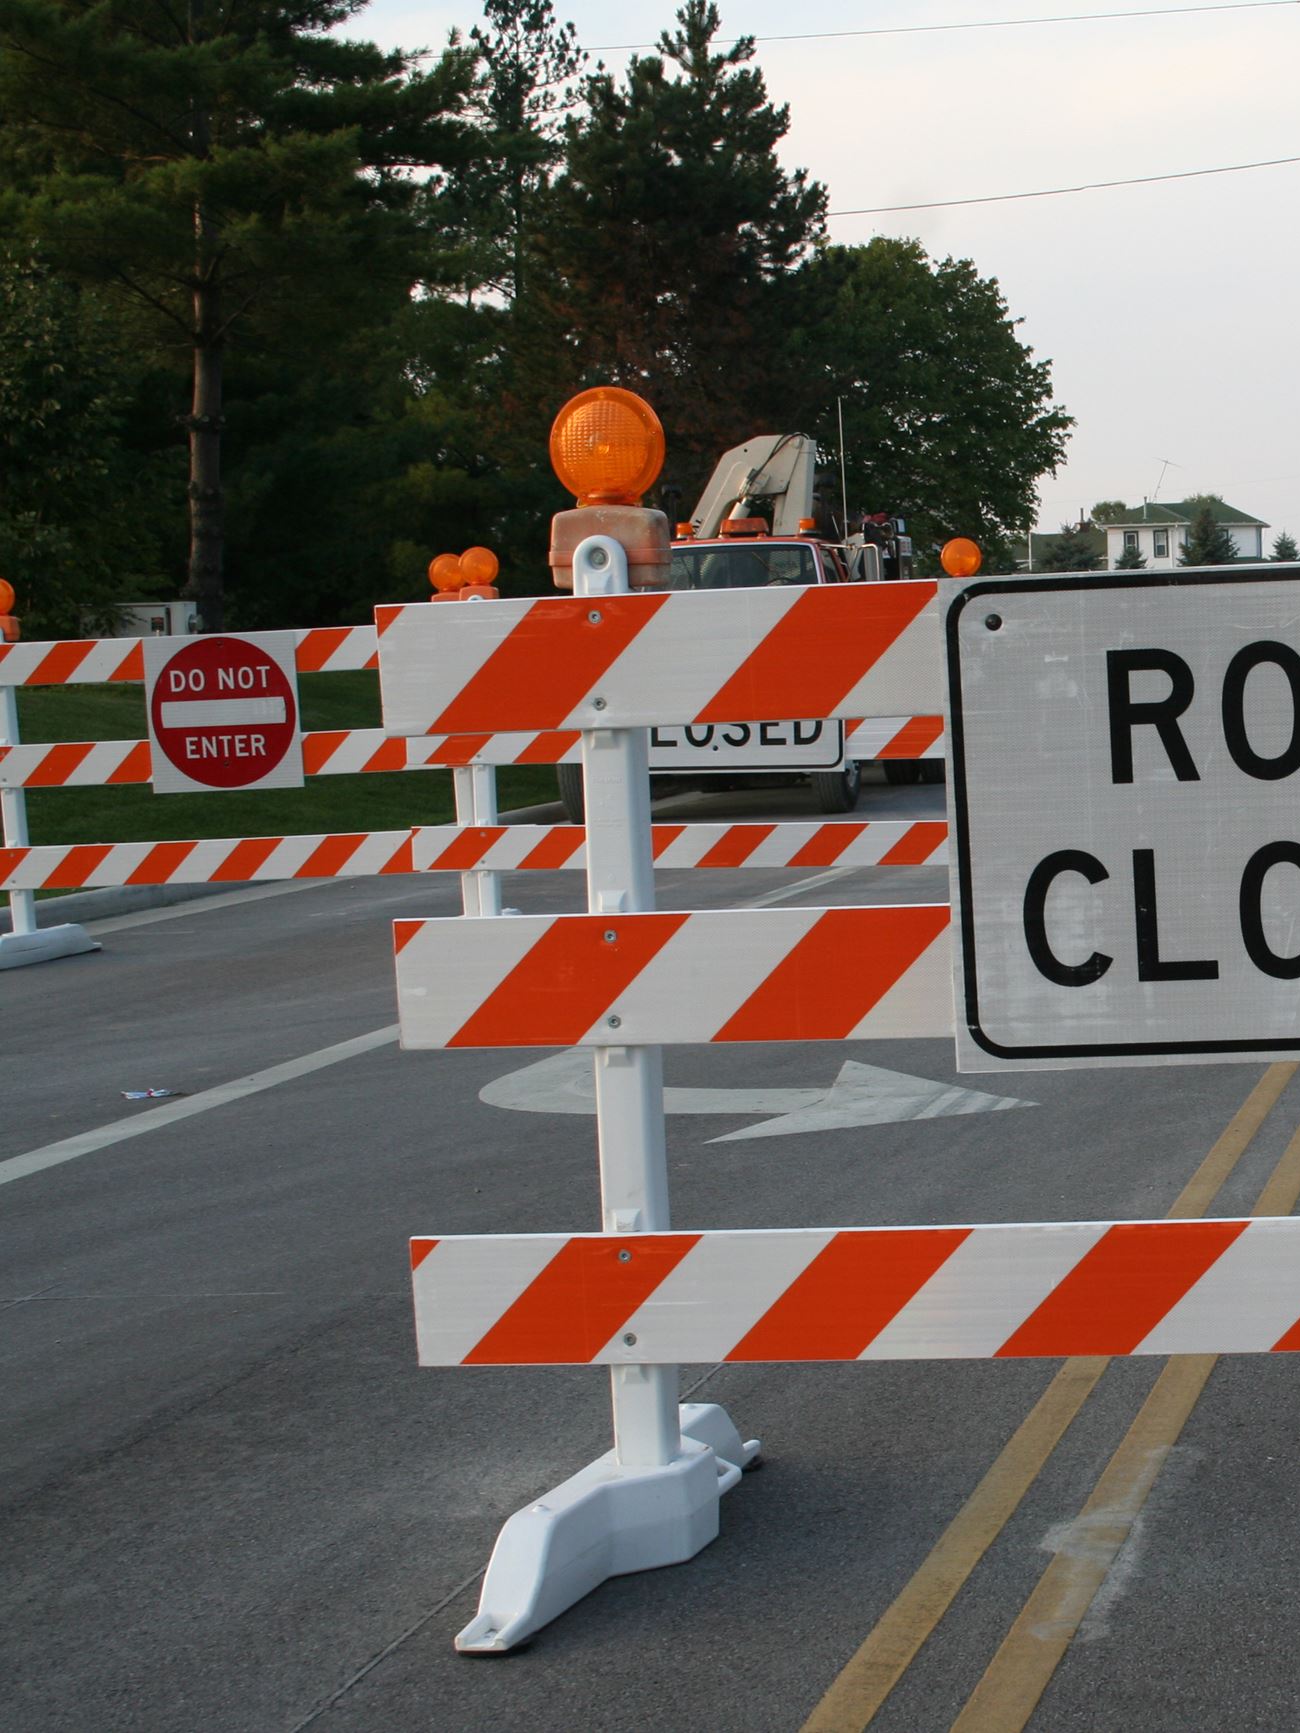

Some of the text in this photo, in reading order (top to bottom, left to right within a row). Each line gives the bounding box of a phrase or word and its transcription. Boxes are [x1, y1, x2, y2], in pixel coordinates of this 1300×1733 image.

[169, 665, 271, 693] DO NOT
[185, 734, 266, 759] ENTER
